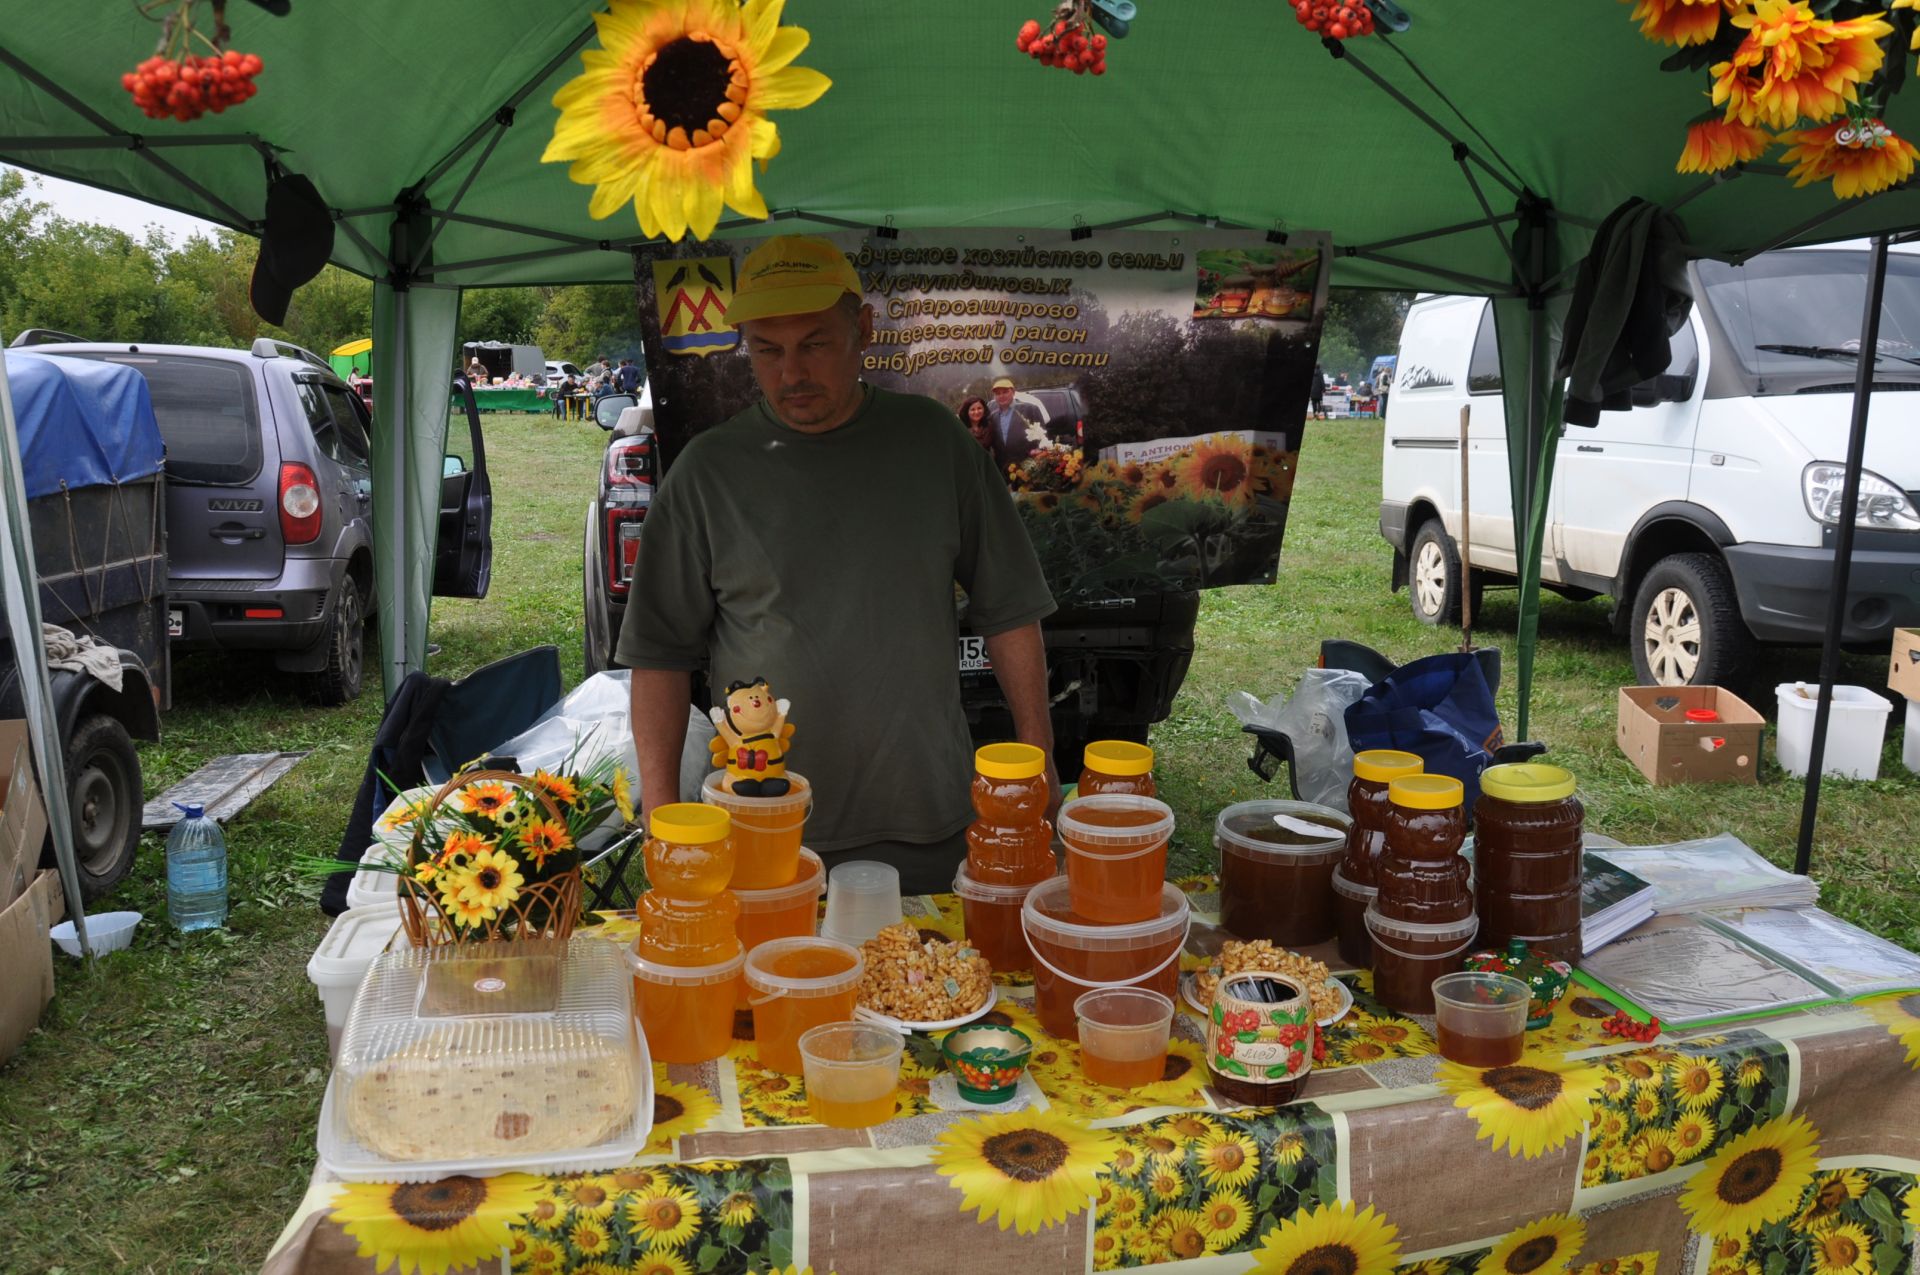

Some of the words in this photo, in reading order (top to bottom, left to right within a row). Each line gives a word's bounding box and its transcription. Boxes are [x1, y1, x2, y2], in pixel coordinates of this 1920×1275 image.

[844, 246, 957, 268] одческое
[962, 246, 1102, 268] хозяйство
[1108, 252, 1184, 270] семьи
[866, 269, 1072, 296] Хуснутдиновых
[887, 298, 1078, 320] Староаширово
[870, 321, 1006, 345] атвеевский
[1011, 324, 1087, 343] район
[863, 345, 993, 375] енбургской
[999, 346, 1109, 368] области
[211, 500, 260, 511] NIVA
[961, 660, 983, 668] RUS
